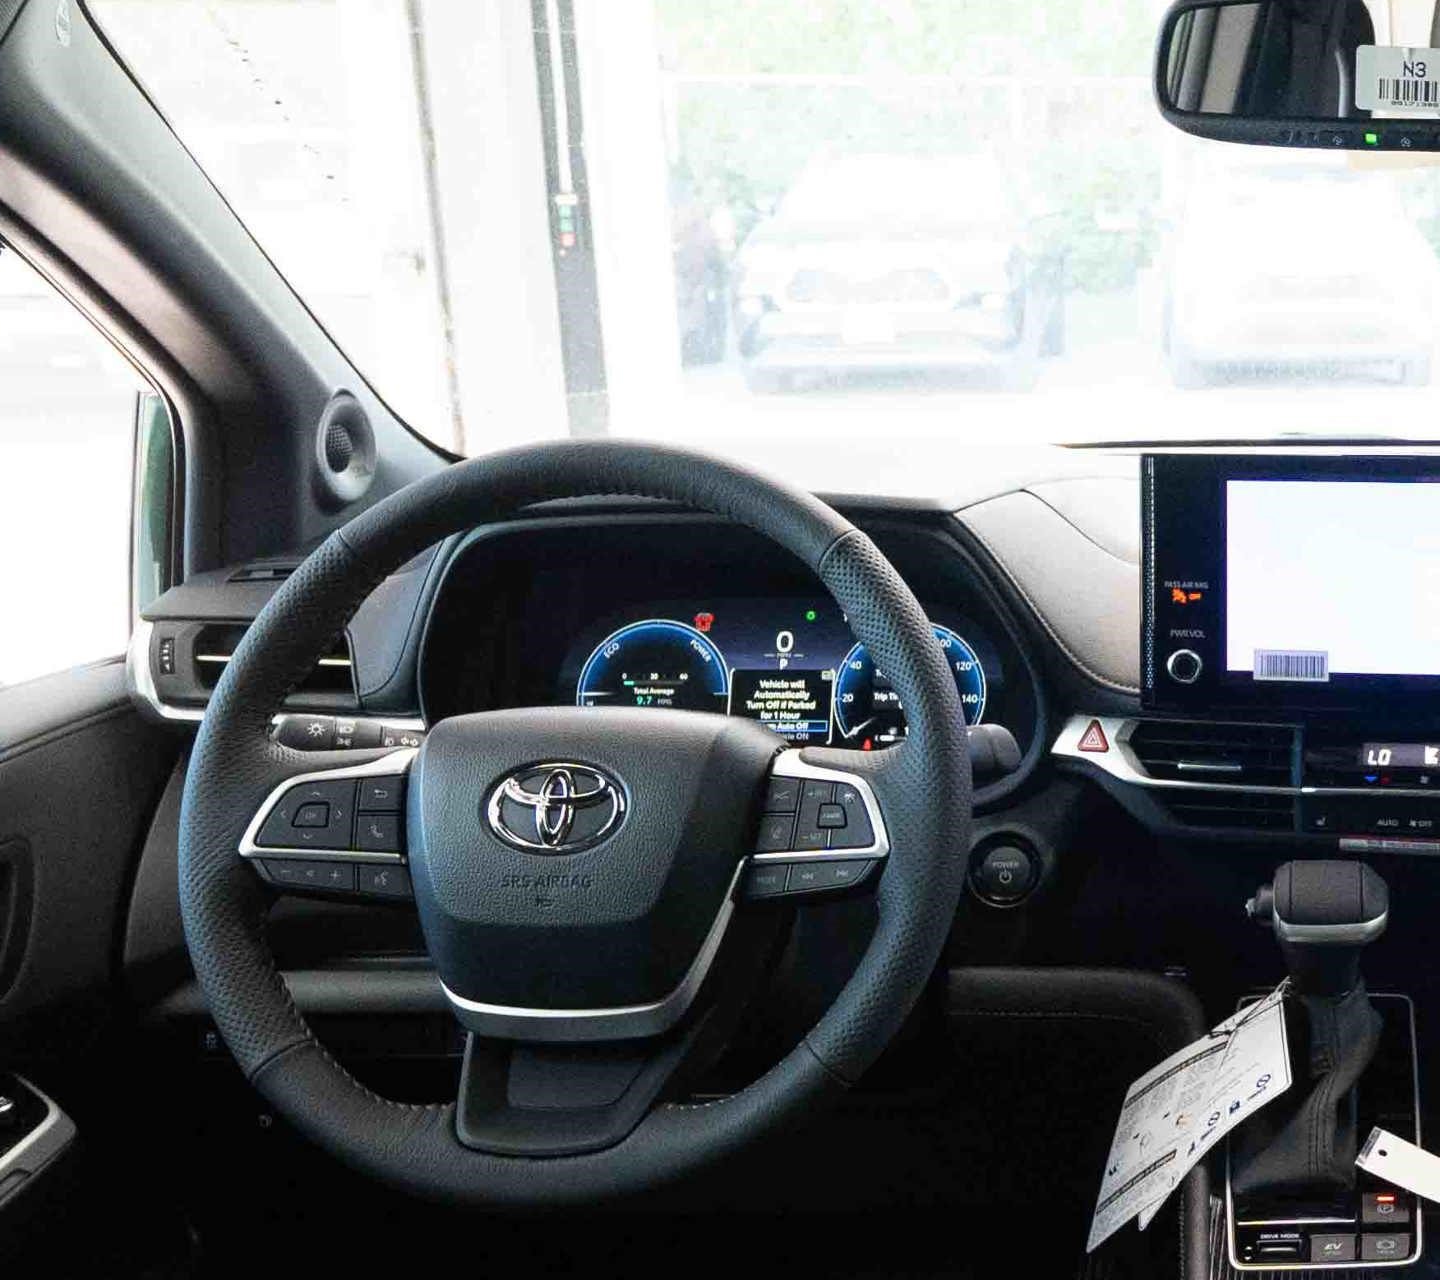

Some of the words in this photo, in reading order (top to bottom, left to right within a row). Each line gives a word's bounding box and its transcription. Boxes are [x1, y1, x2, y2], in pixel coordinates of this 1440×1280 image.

[1403, 61, 1427, 78] N3
[776, 630, 794, 653] 0
[939, 639, 952, 648] 00
[603, 642, 620, 659] ECO
[690, 639, 712, 663] POWER
[779, 659, 789, 670] P
[850, 661, 862, 669] 40
[956, 661, 971, 670] 120
[759, 680, 789, 689] Vehicle
[790, 680, 805, 688] will
[633, 687, 649, 695] Total
[650, 687, 675, 696] Average
[753, 690, 810, 700] Automatically
[636, 696, 653, 705] 9.7
[842, 693, 853, 702] 20
[873, 693, 888, 702] Trip
[961, 694, 978, 703] 140
[746, 701, 765, 709] Turn
[766, 701, 780, 709] Off
[788, 701, 816, 710] Parked
[760, 711, 773, 719] for
[780, 711, 801, 720] Hour
[1367, 748, 1392, 766] LO
[992, 861, 1019, 869] POWER
[536, 874, 593, 889] AIRBAG
[1324, 1242, 1343, 1250] EV
